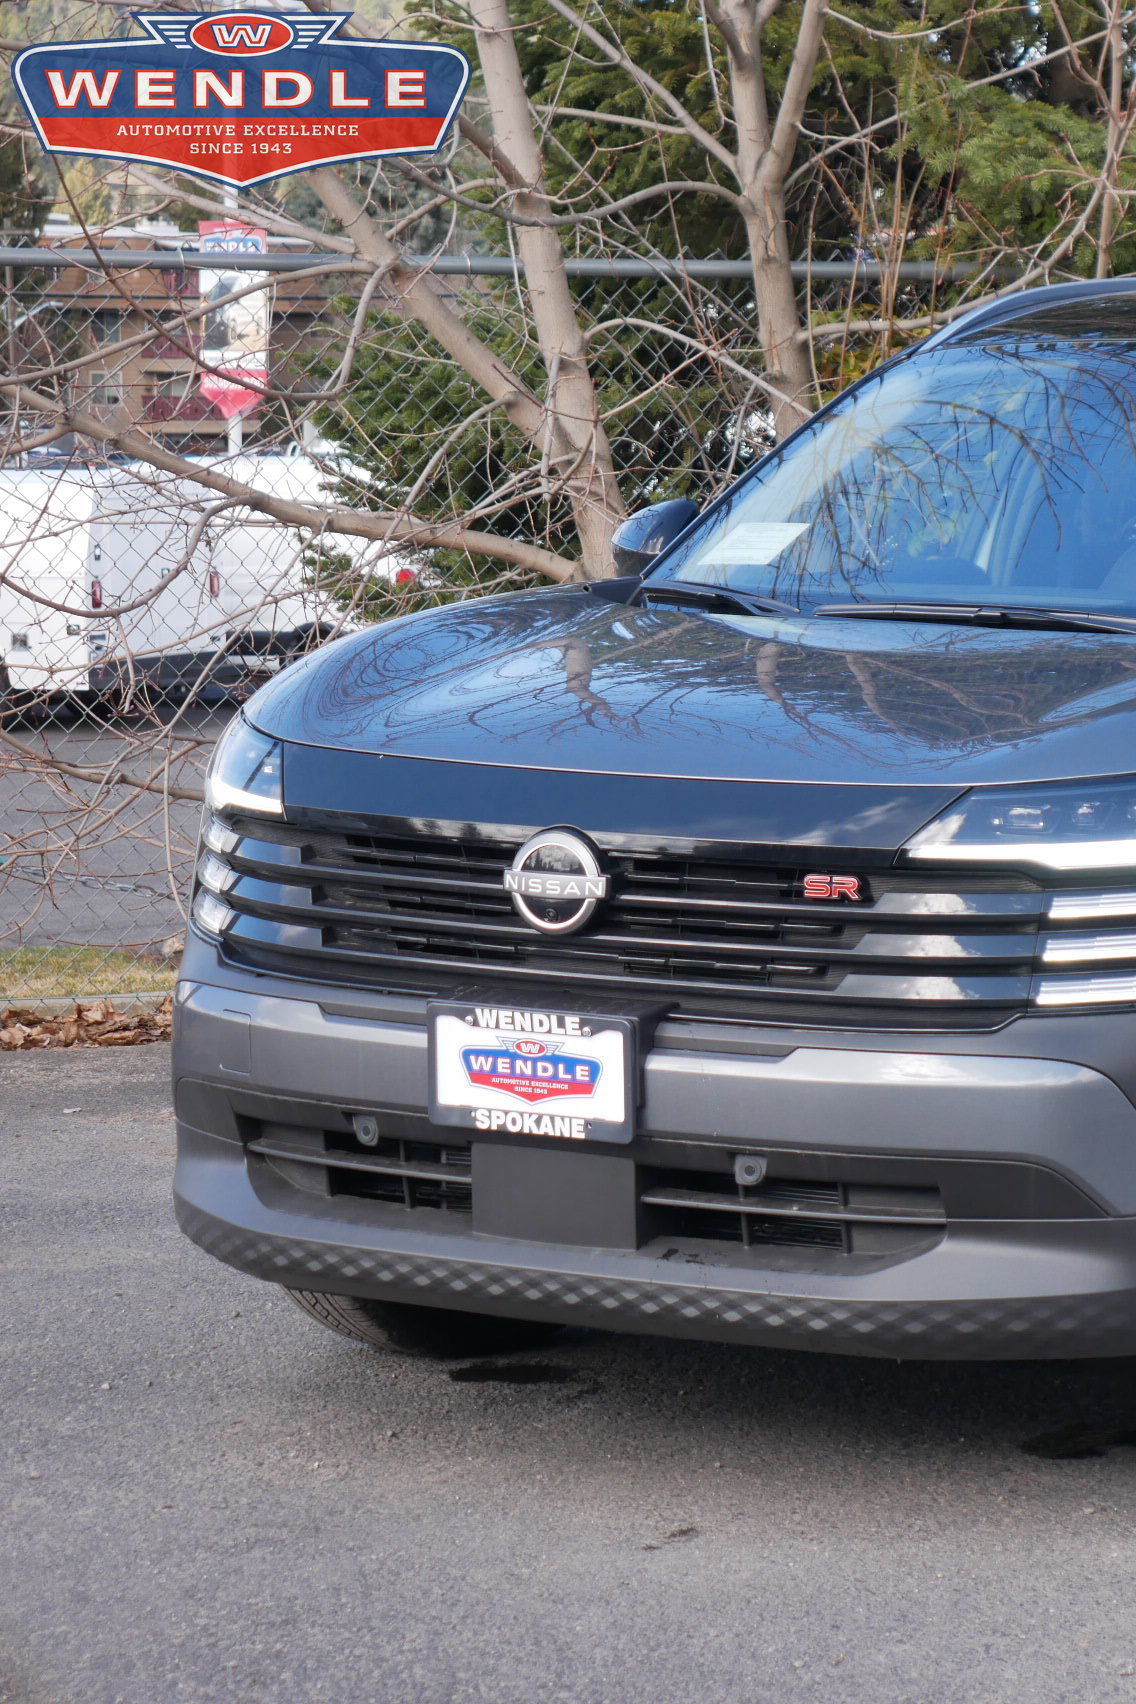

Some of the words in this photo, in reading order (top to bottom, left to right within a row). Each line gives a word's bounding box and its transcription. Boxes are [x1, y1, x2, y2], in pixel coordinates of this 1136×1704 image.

[505, 874, 602, 896] NISSAN
[804, 874, 861, 900] SR
[474, 1008, 582, 1036] WENDLE
[469, 1055, 590, 1081] WENDLE
[491, 1077, 530, 1086] AUTOMOTIVE
[531, 1080, 569, 1090] EXCELLENCE
[475, 1108, 586, 1139] SPOKANE
